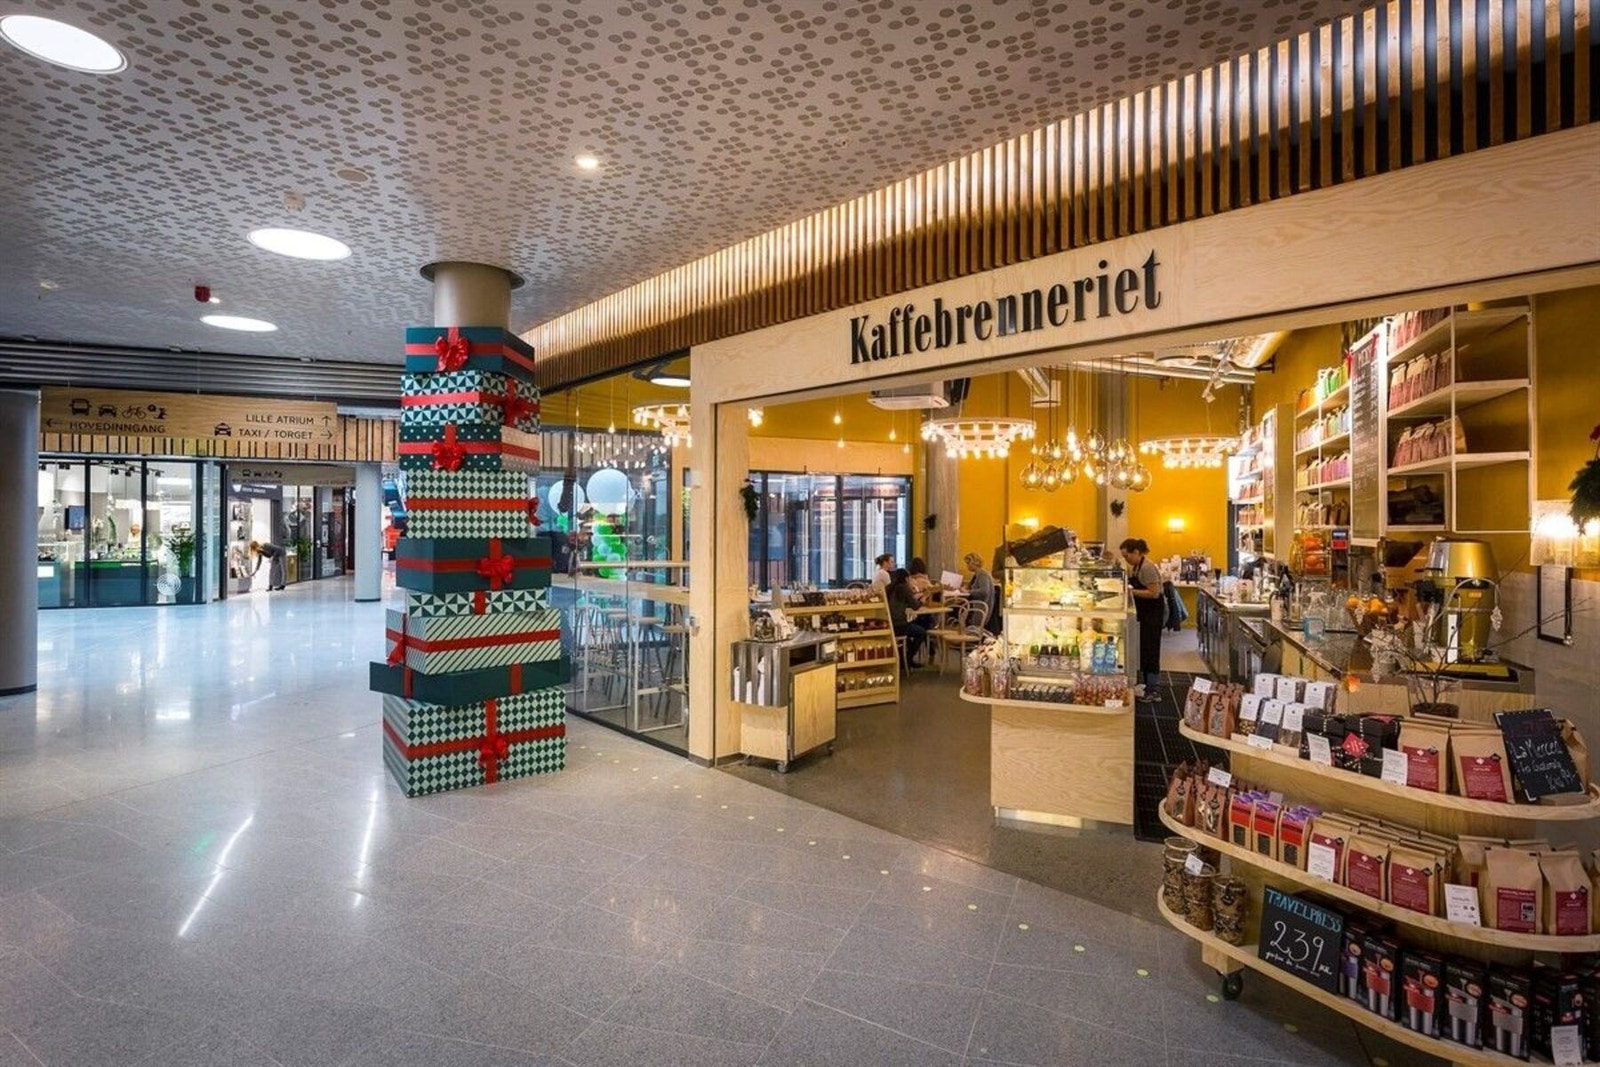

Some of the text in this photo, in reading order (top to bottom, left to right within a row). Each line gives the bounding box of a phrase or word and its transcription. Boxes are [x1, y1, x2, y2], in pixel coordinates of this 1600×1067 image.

[849, 249, 1162, 365] Kaffebrenneriet
[246, 414, 314, 425] LILLE ATRIUM
[69, 421, 166, 434] HOVEDINNGANG
[239, 428, 261, 437] TAXI
[274, 430, 313, 440] TORGET
[1269, 920, 1325, 972] 239
